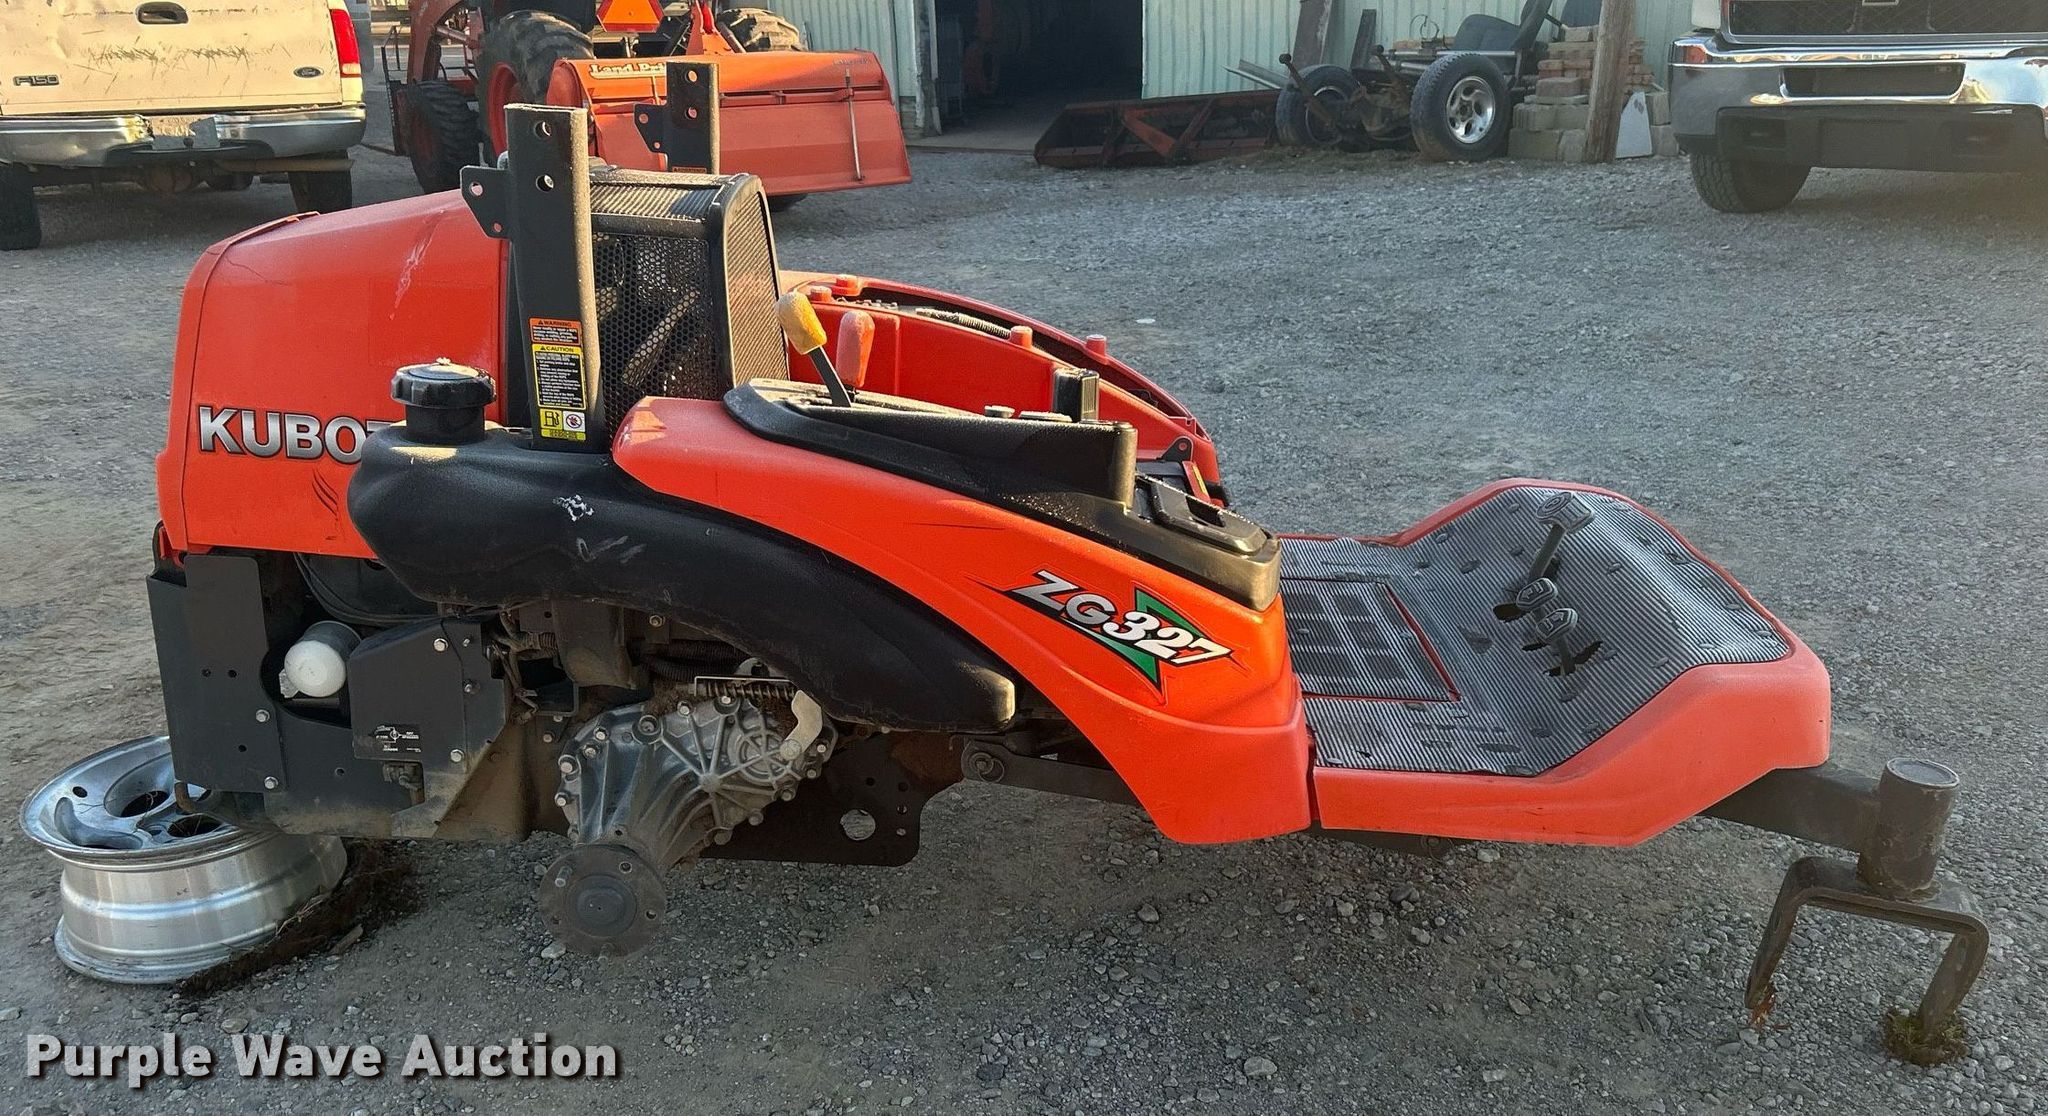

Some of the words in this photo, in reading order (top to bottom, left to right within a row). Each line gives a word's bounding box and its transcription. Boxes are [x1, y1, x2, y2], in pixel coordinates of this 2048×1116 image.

[589, 63, 634, 75] Land
[637, 62, 665, 75] Pri
[199, 405, 395, 465] KUBO
[1010, 568, 1233, 665] ZG327
